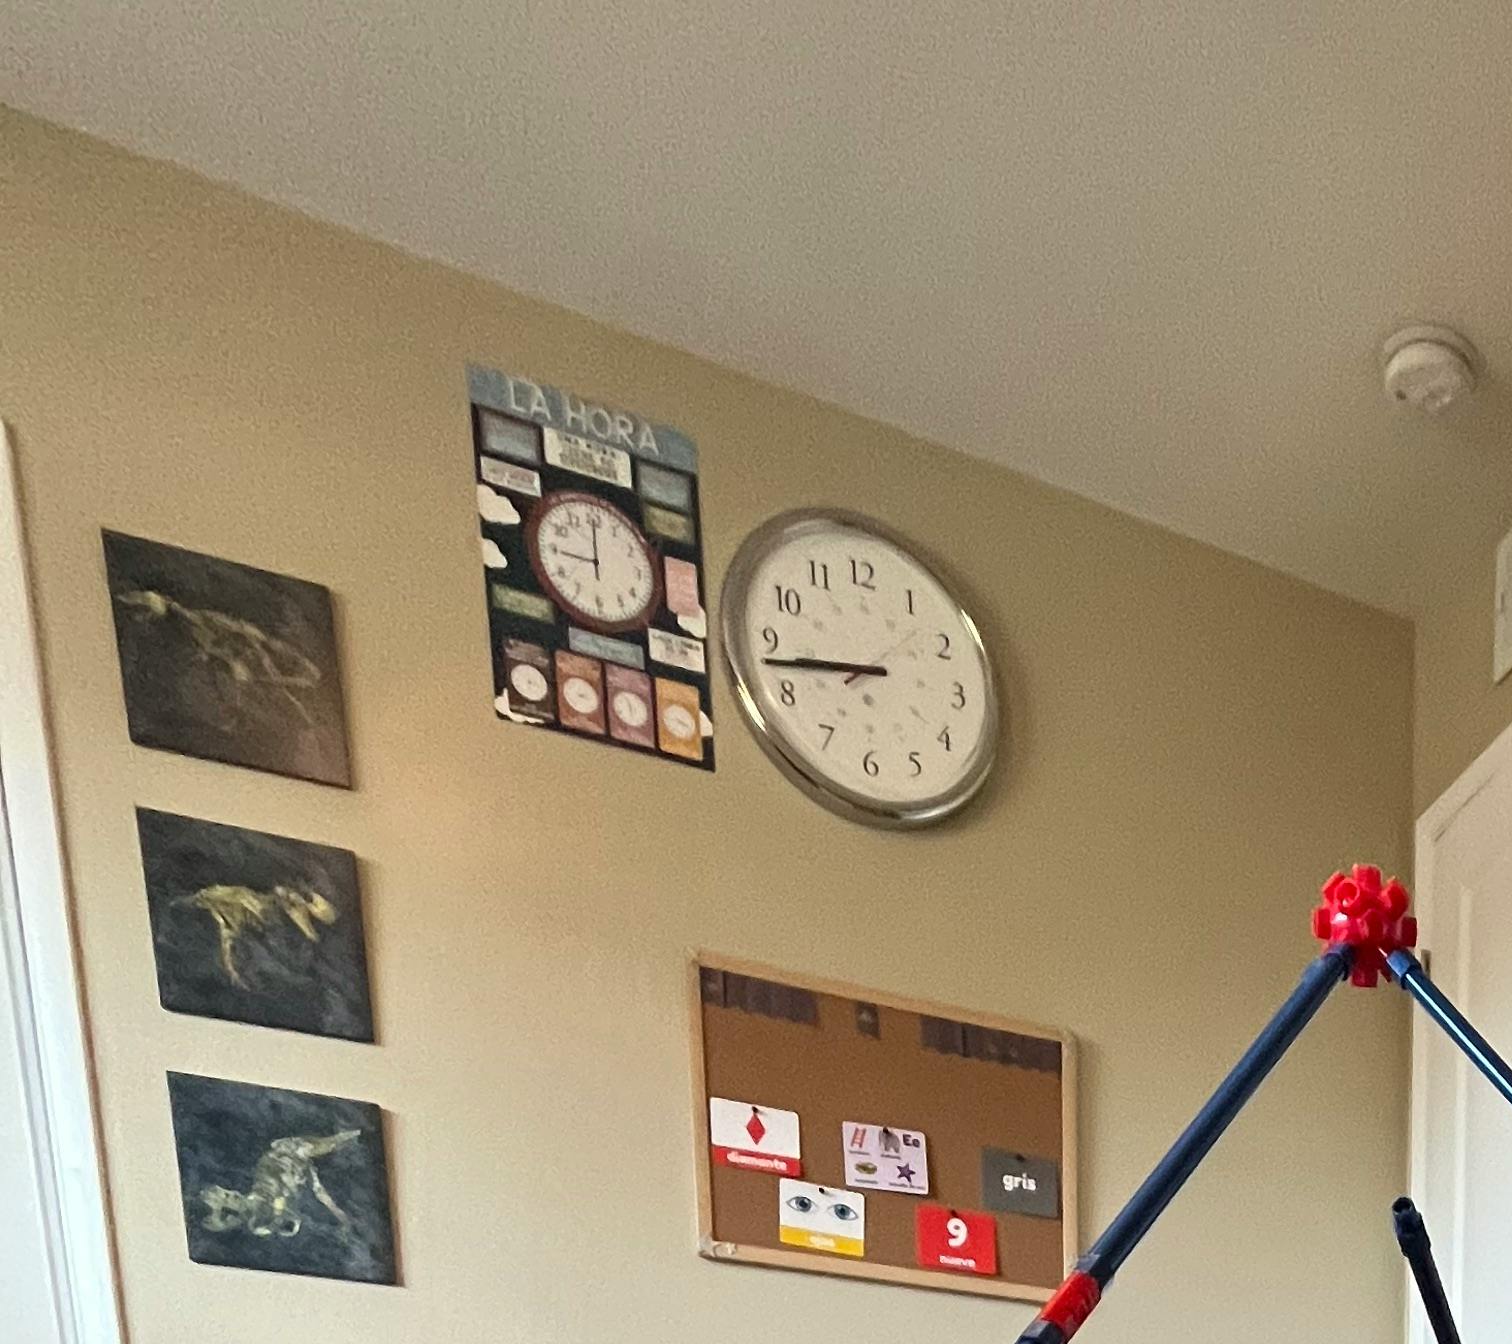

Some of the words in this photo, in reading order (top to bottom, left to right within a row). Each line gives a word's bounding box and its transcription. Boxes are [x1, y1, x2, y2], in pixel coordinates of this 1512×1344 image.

[509, 379, 551, 421] LA
[562, 391, 660, 457] HORA
[809, 560, 831, 592] 11
[850, 559, 876, 591] 12
[775, 585, 801, 616] 10
[906, 589, 915, 616] 1
[763, 626, 778, 654] 9
[936, 633, 951, 660] 2
[781, 680, 795, 706] 8
[951, 681, 966, 710] 3
[818, 723, 835, 751] 7
[936, 726, 951, 752] 4
[863, 750, 879, 777] 6
[908, 751, 922, 777] 5
[1002, 1172, 1036, 1191] gris
[946, 1217, 968, 1247] 9
